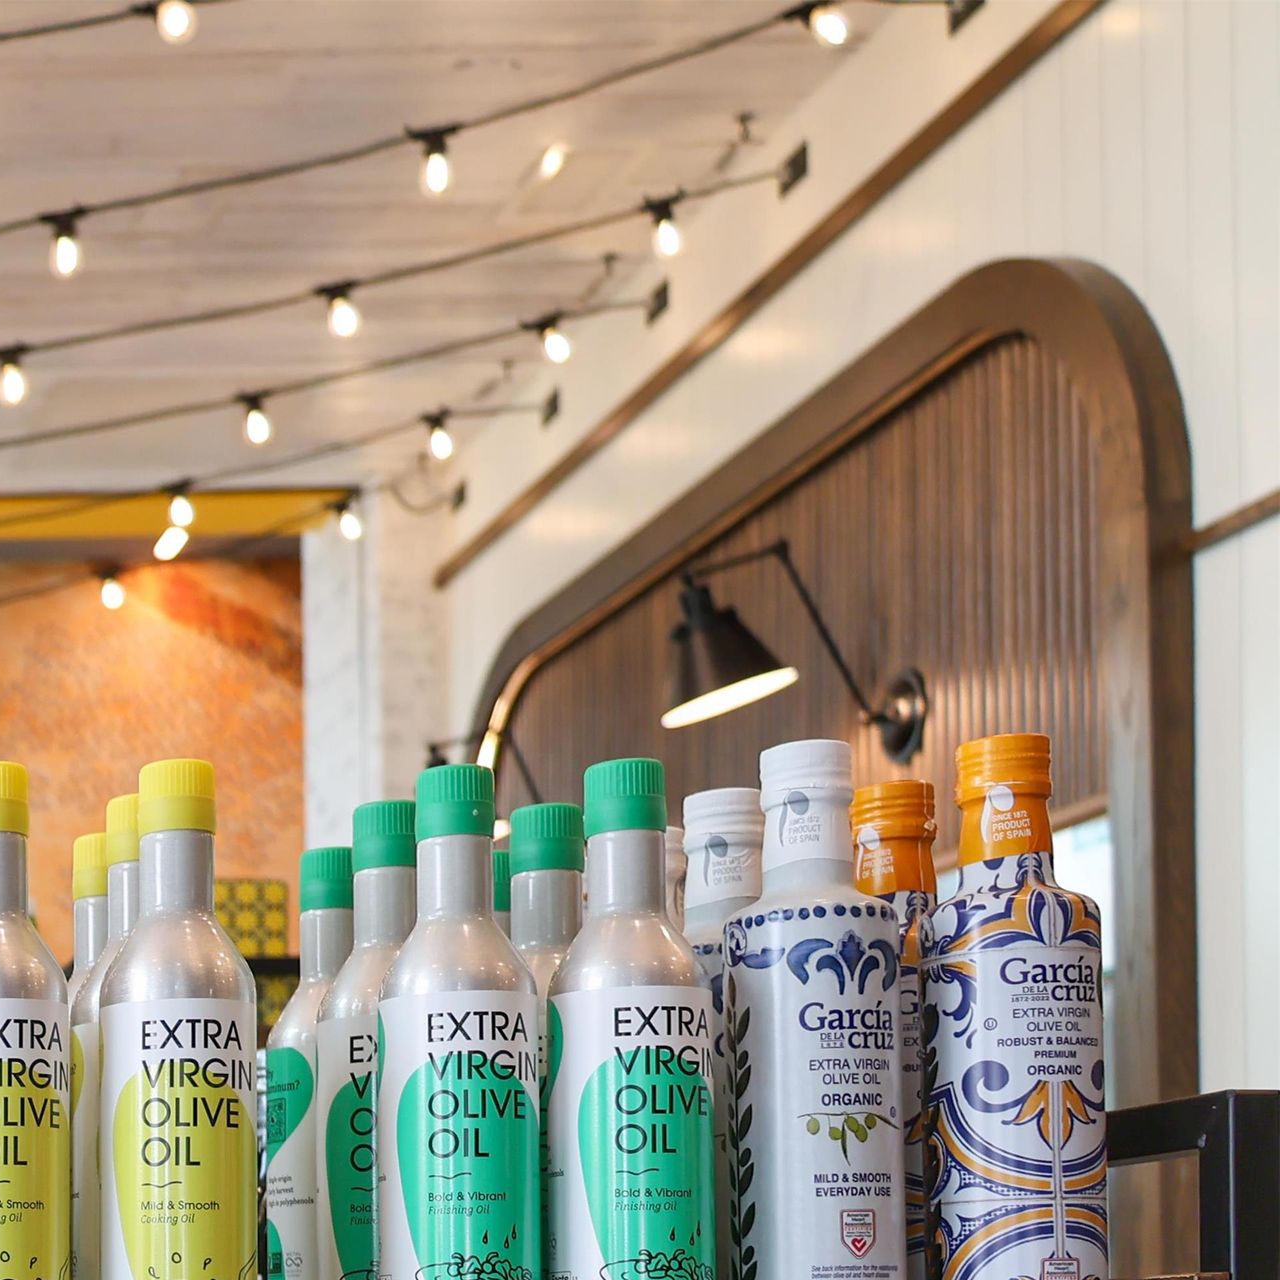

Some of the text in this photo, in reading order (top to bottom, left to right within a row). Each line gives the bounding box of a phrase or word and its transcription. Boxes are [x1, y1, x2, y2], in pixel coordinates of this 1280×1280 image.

[1000, 957, 1094, 985] García
[1050, 981, 1094, 1002] cruz
[799, 1002, 893, 1032] García
[1013, 1007, 1090, 1019] EXTRA VIRGIN
[1027, 1021, 1082, 1033] OLIVE OIL
[141, 1019, 241, 1050] EXTRA
[847, 1029, 894, 1049] cruz
[997, 1037, 1098, 1047] ROBUST & BALANCED
[1034, 1050, 1077, 1059] PREMIUM
[809, 1059, 890, 1071] EXTRA VIRGIN
[1027, 1064, 1082, 1076] ORGANIC
[141, 1058, 252, 1091] VIRGIN
[823, 1072, 881, 1085] OLIVE OIL
[821, 1093, 882, 1106] ORGANIC
[141, 1098, 240, 1128] OLIVE
[141, 1137, 201, 1166] OIL
[814, 1173, 891, 1184] MILD & SMOOTH
[428, 1191, 506, 1202] Bold & Vibrant
[815, 1187, 891, 1198] EVERYDAY USE
[141, 1200, 220, 1211] Mild & Smooth
[428, 1204, 489, 1216] Finishing Oil
[141, 1214, 194, 1225] Cooking Oil
